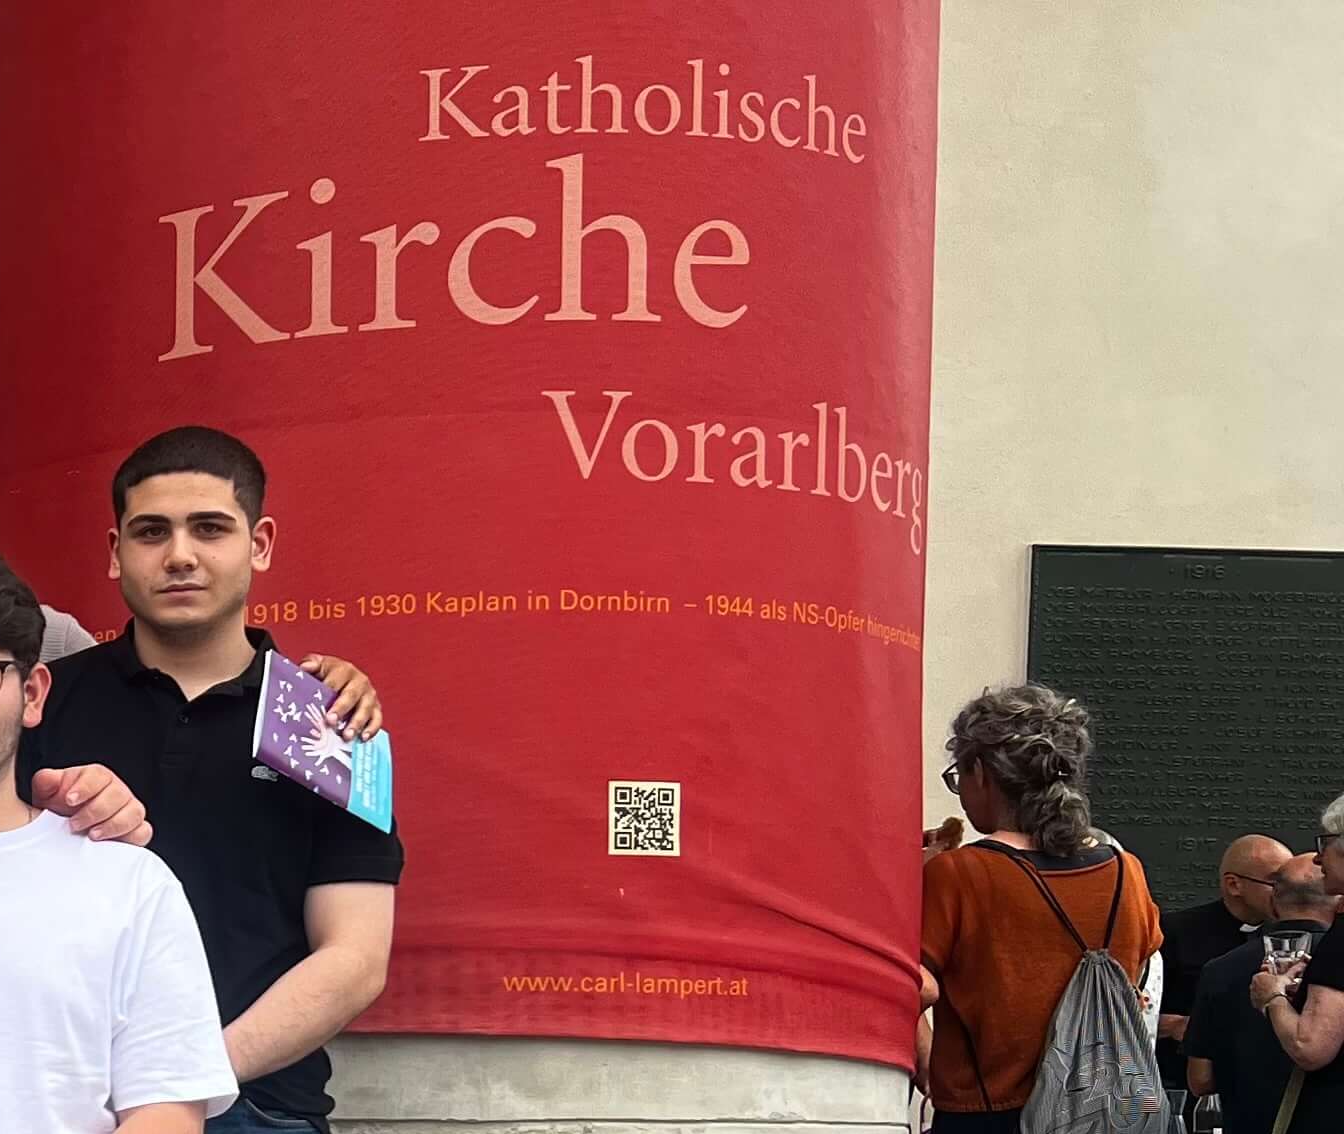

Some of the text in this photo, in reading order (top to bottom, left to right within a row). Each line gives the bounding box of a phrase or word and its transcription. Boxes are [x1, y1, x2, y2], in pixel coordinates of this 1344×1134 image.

[418, 55, 868, 165] Katholische
[157, 152, 751, 363] Kirche
[540, 390, 923, 555] Vorarlberg
[309, 599, 347, 620] bis
[357, 593, 416, 617] 1930
[425, 590, 517, 618] Kaplan
[527, 590, 550, 611] in
[560, 589, 670, 613] Dornbirn
[704, 594, 754, 617] 1944
[760, 599, 788, 621] als
[792, 601, 865, 633] NS-Opfer
[503, 971, 748, 999] www.carl-lampert.at
